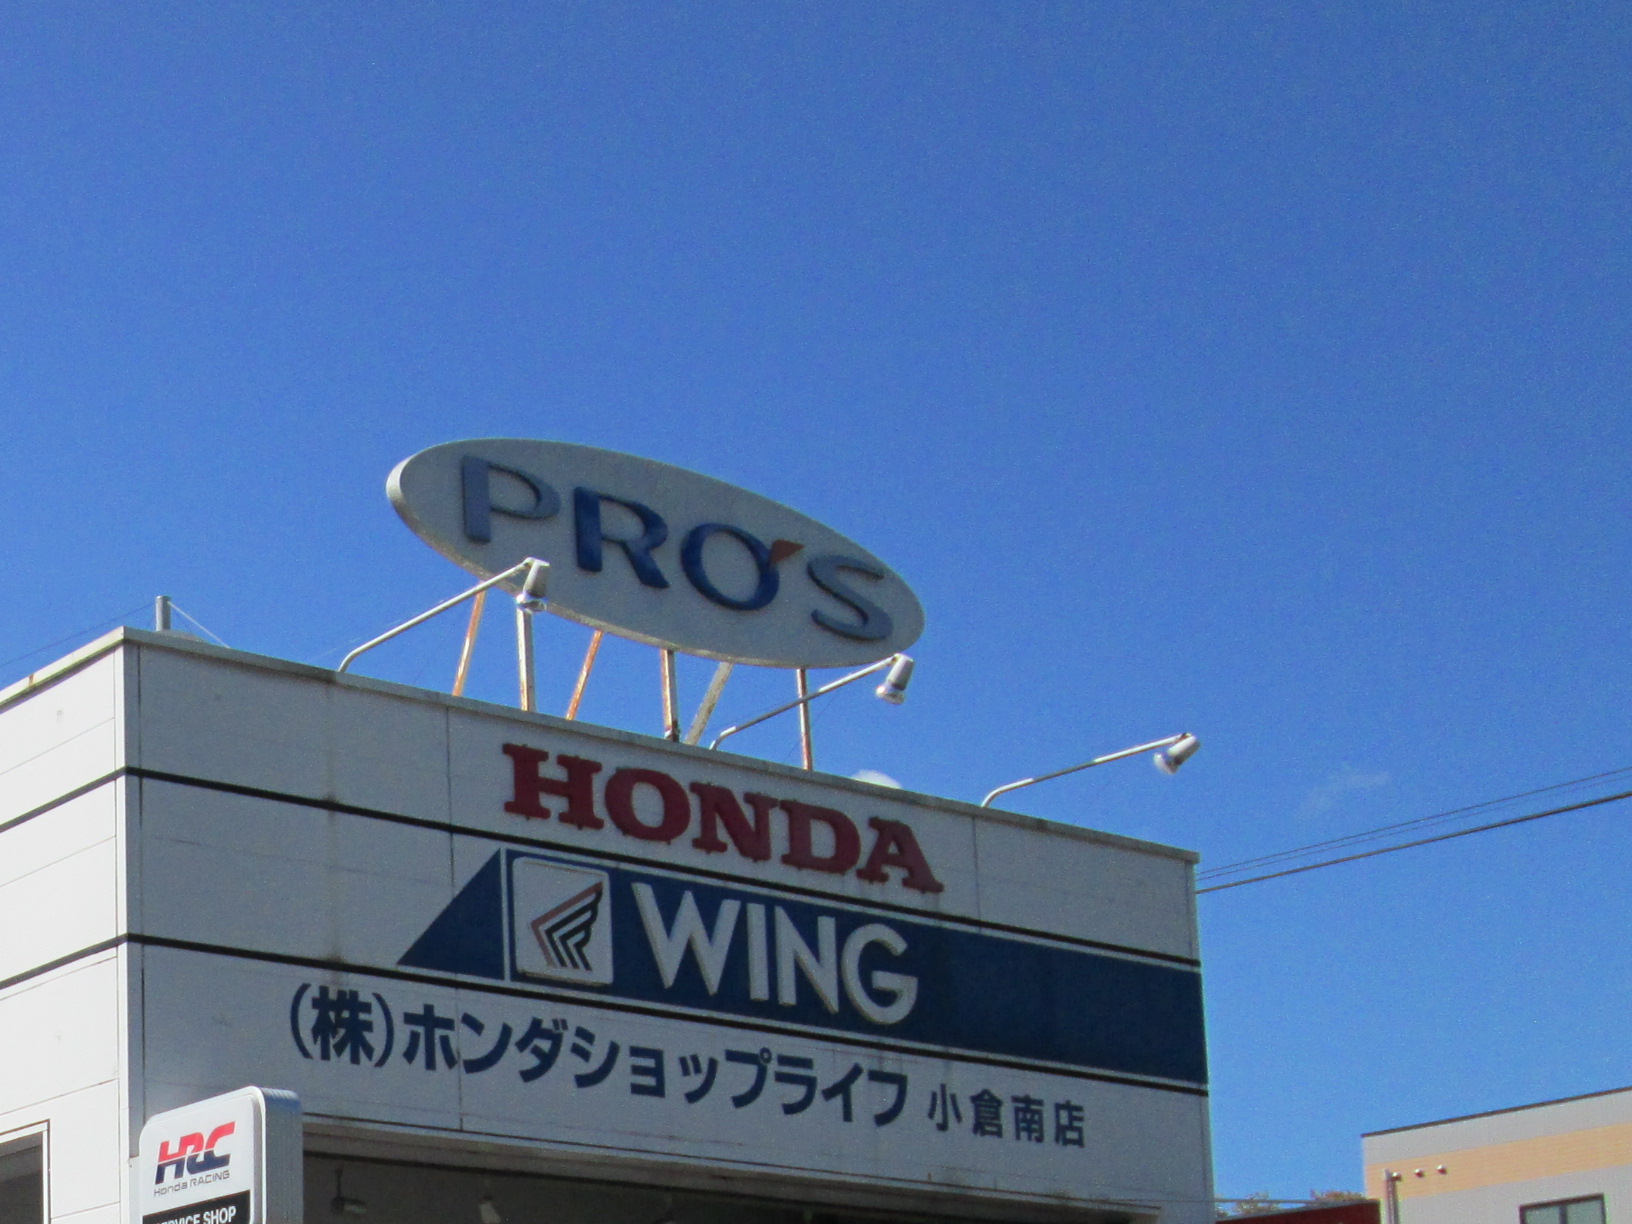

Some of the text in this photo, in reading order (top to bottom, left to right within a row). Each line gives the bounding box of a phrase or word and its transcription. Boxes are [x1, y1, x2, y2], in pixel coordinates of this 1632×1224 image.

[501, 743, 945, 894] HONDA
[631, 881, 919, 1026] WING
[153, 1169, 231, 1197] Honda RACING
[155, 1121, 236, 1185] HRC
